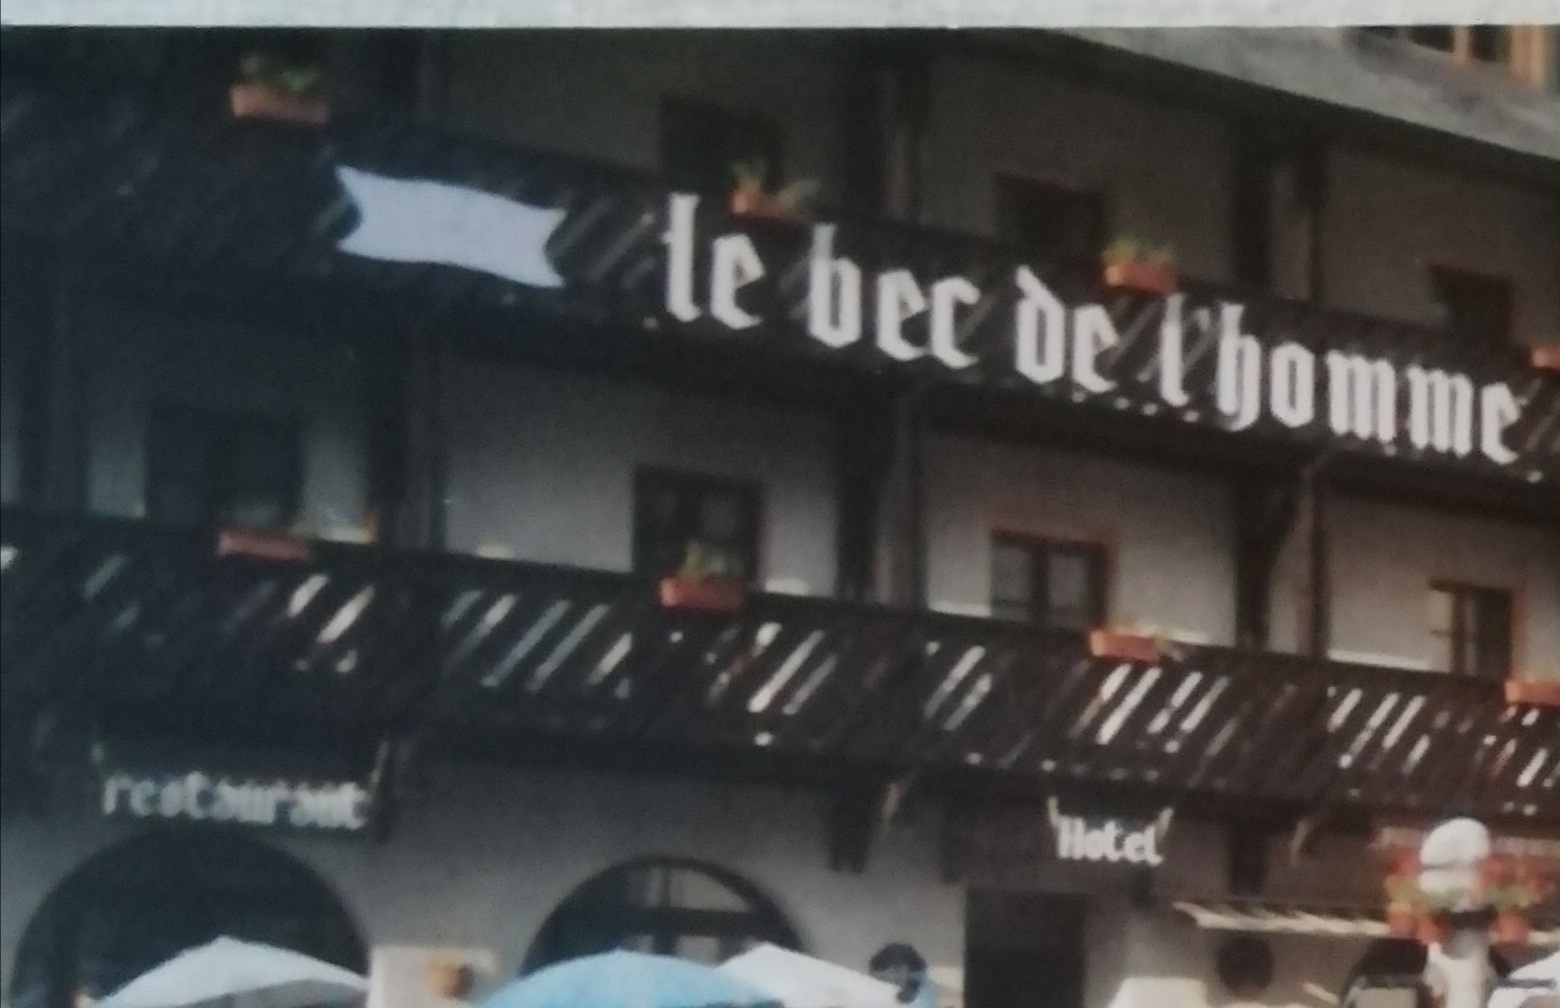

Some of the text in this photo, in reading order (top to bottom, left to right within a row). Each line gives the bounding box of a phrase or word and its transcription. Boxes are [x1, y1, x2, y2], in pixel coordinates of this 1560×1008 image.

[664, 192, 1526, 465] le bec de l'homme
